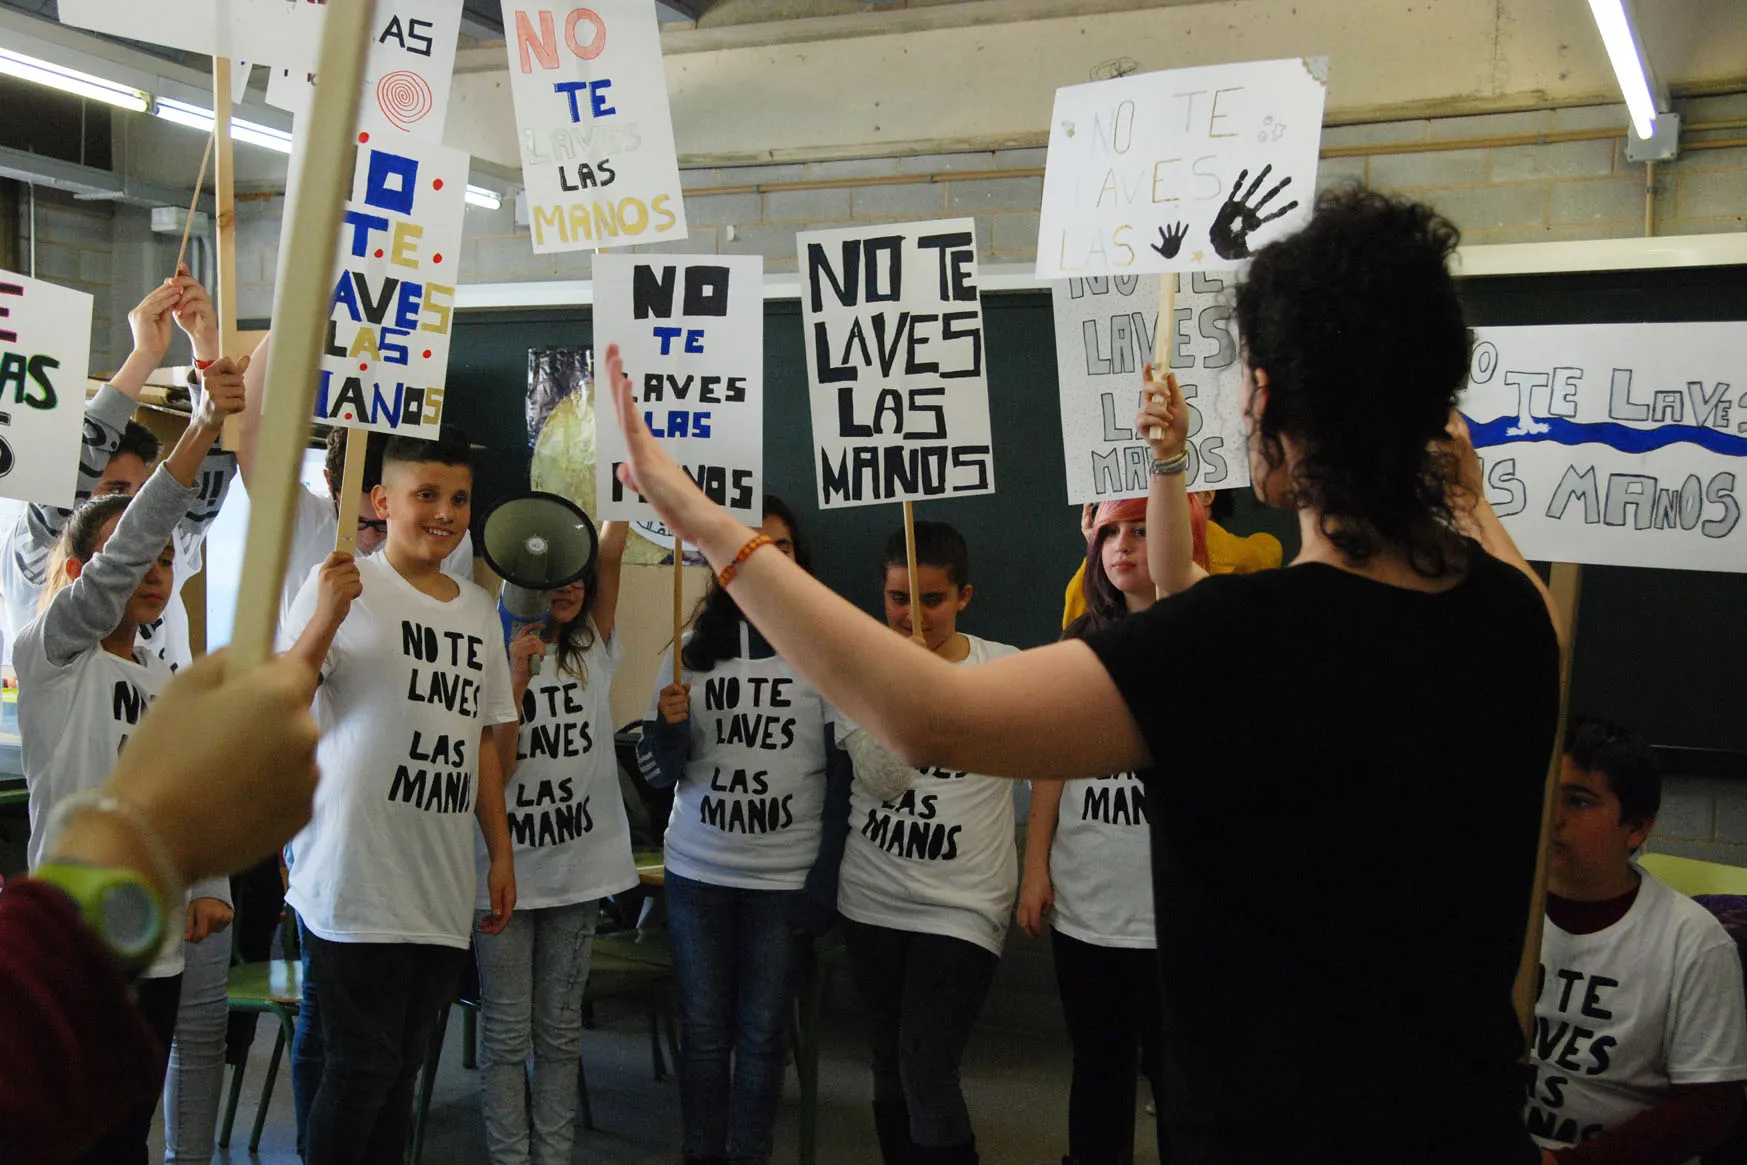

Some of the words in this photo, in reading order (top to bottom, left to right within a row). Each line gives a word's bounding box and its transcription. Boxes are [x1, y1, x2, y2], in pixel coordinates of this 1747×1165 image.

[379, 15, 433, 57] AS
[515, 7, 607, 74] NO
[553, 78, 617, 123] TE
[1091, 100, 1135, 156] NO
[1172, 87, 1245, 139] TE
[523, 122, 643, 165] LAVES
[345, 144, 419, 216] O
[558, 158, 616, 192] LAS
[343, 209, 424, 270] TE
[532, 194, 677, 245] MANOS
[807, 235, 906, 313] NO
[917, 232, 978, 301] TE
[1060, 224, 1135, 271] LAS
[330, 269, 456, 335] AVES
[633, 265, 730, 319] NO
[653, 327, 705, 355] TE
[814, 311, 981, 384] LAVES
[1470, 341, 1498, 385] O
[0, 351, 60, 411] AS
[1504, 367, 1584, 437] TE
[644, 411, 712, 439] LAS
[838, 386, 947, 440] LAS
[1100, 384, 1204, 442] LS
[821, 445, 990, 504] MANOS
[1091, 436, 1229, 495] MAOS
[1545, 464, 1741, 538] MANOS
[401, 620, 439, 663] NO
[443, 631, 483, 672] TE
[407, 668, 480, 719] LAVES
[519, 688, 536, 726] O
[540, 682, 583, 718] TE
[704, 676, 740, 710] NO
[747, 677, 793, 708] TE
[409, 729, 466, 768] LAS
[716, 713, 796, 750] LAVES
[516, 777, 574, 807] LAS
[710, 767, 769, 795] LAS
[1081, 785, 1151, 825] MAN
[700, 793, 793, 834] MANOS
[861, 808, 962, 860] MANOS
[1558, 968, 1619, 1020] TE
